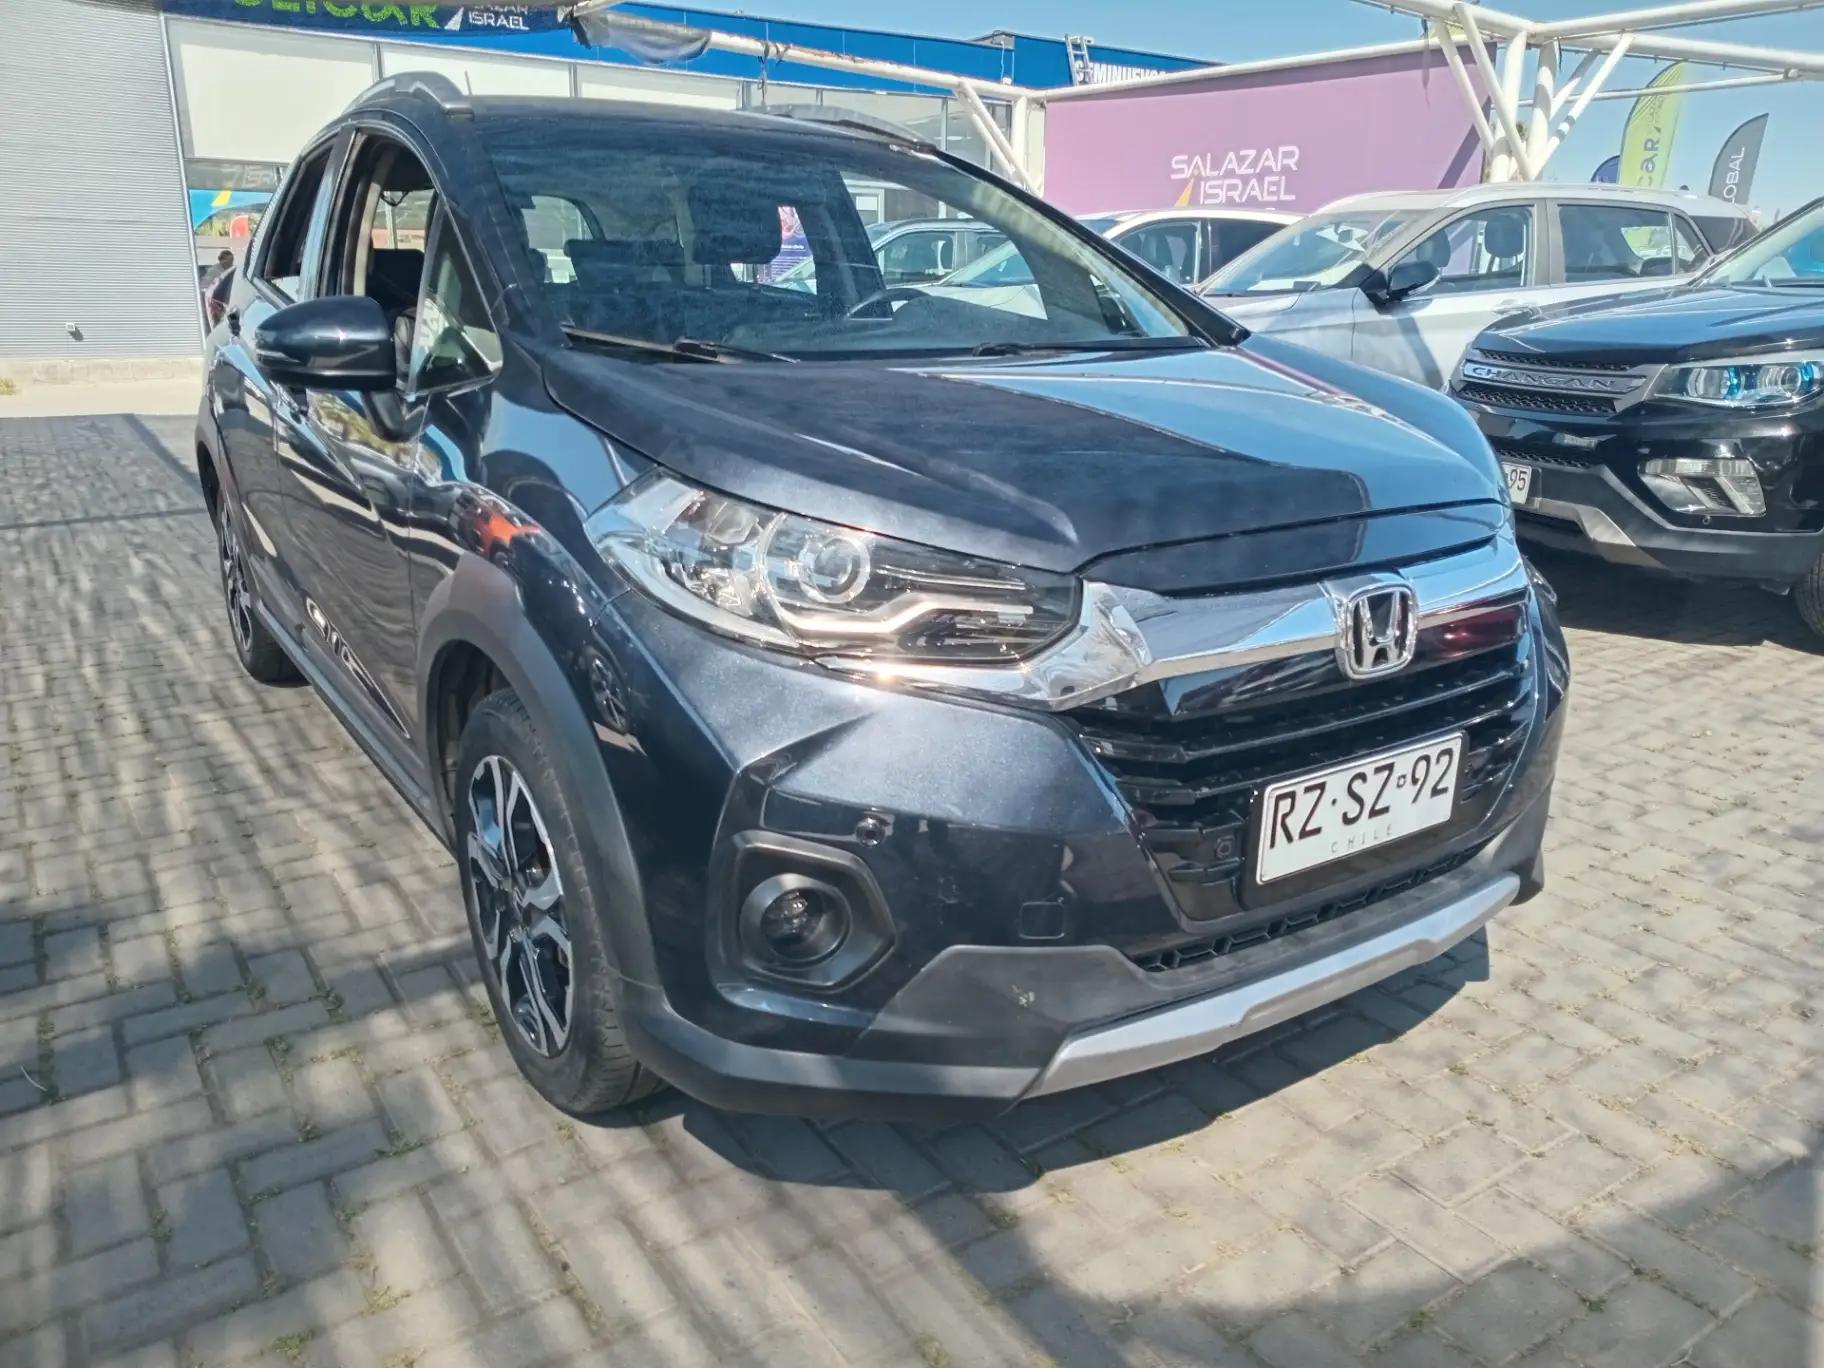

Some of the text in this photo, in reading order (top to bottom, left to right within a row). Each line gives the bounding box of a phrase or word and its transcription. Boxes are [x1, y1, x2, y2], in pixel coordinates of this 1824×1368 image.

[468, 11, 530, 31] ISRAEL
[1170, 145, 1300, 180] SALAZAR
[1199, 175, 1297, 205] ISRAEL
[1472, 366, 1616, 394] CHANGAN
